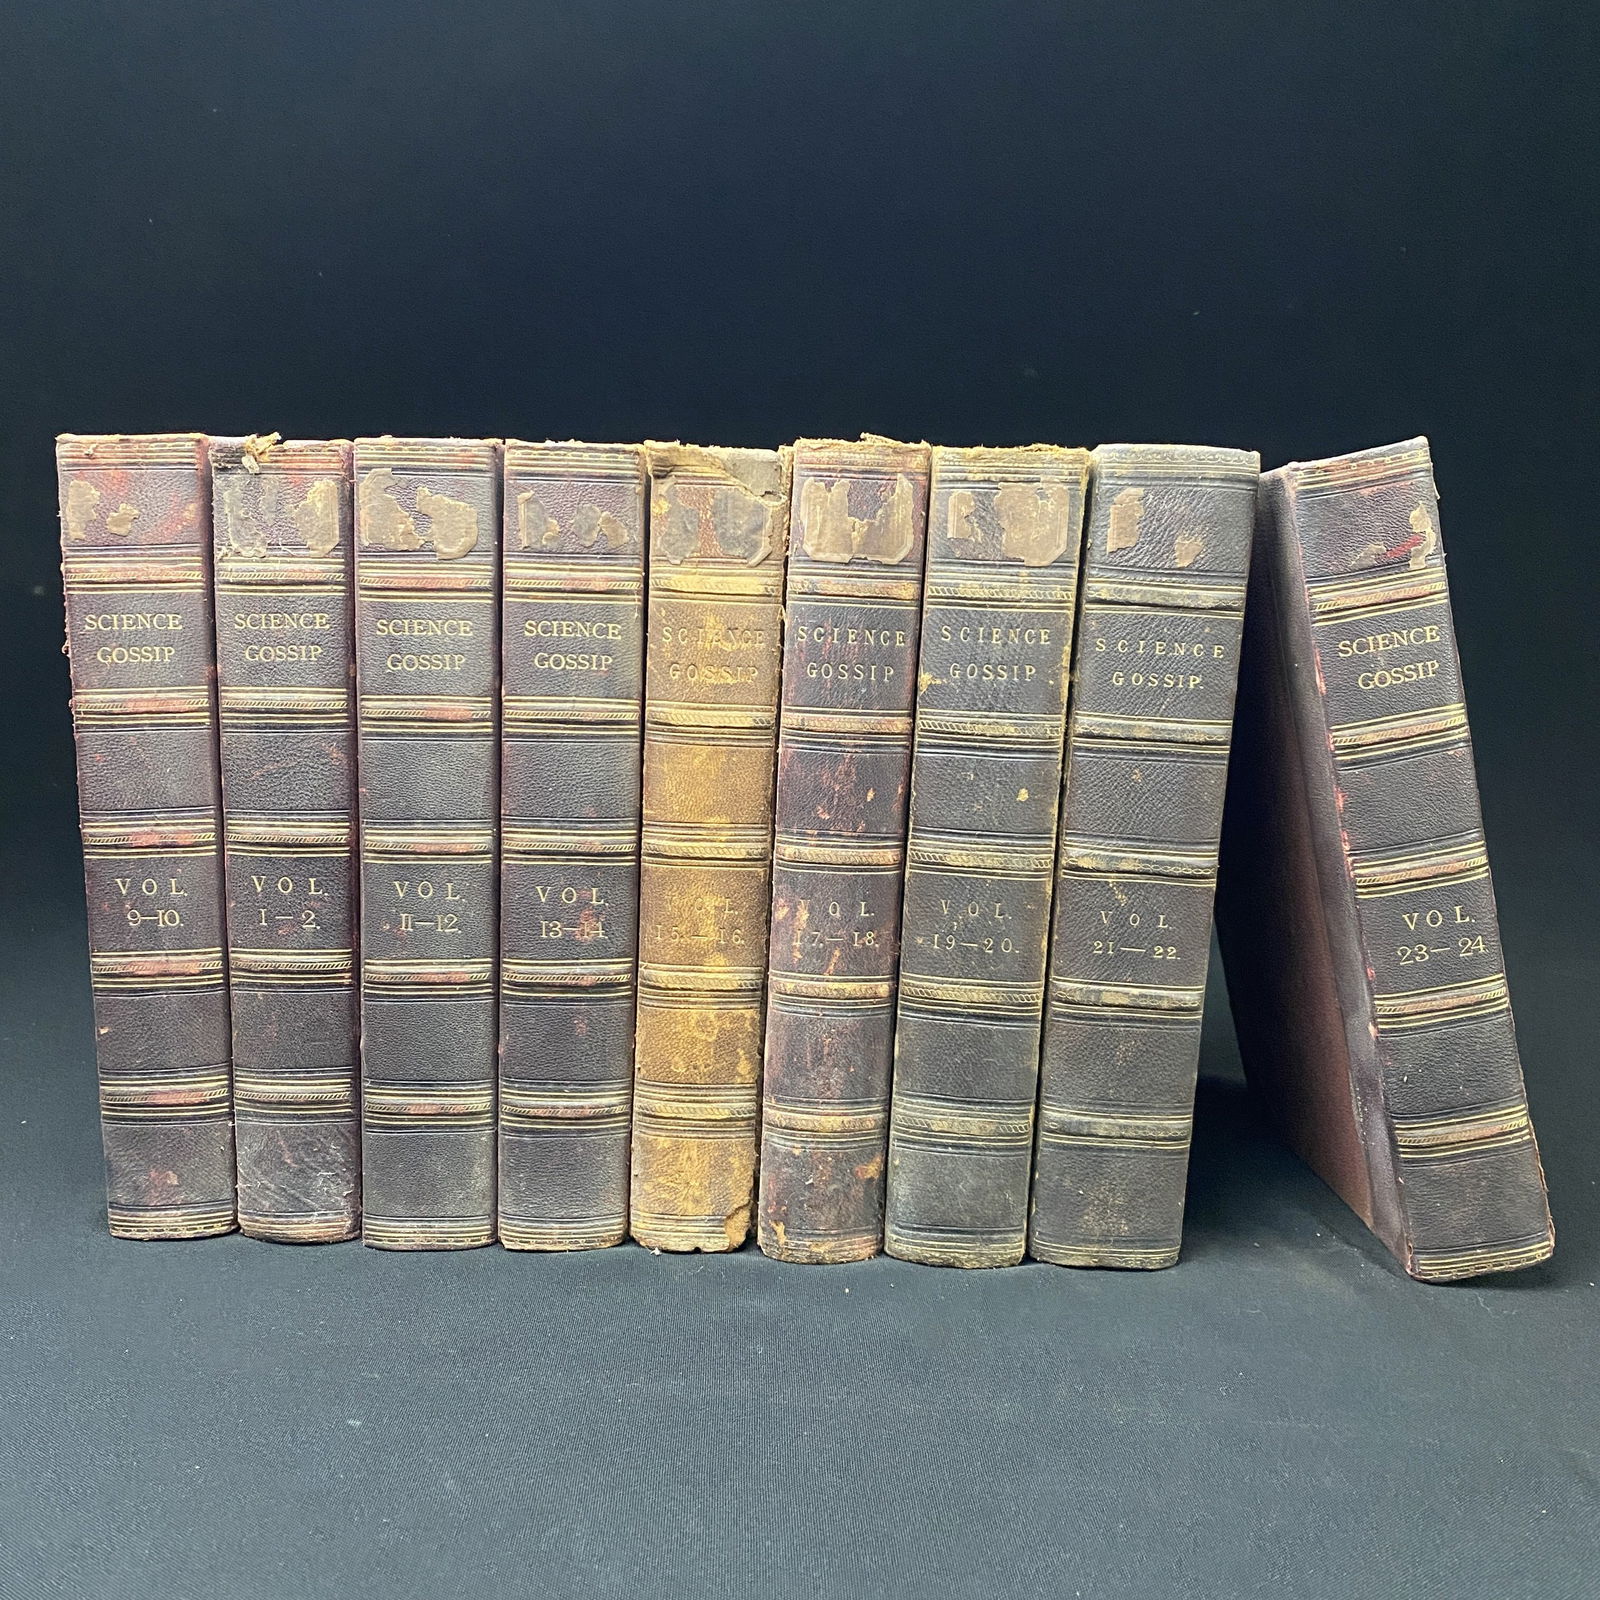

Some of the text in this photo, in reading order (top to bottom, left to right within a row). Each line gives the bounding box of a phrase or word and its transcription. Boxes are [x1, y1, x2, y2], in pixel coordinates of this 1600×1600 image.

[84, 613, 183, 630] SCIENCE
[233, 613, 330, 630] SCIENCE
[375, 619, 473, 636] SCIENCE
[524, 620, 622, 639] SCIENCE
[796, 626, 906, 647] SCIENCE
[941, 626, 1050, 645] SCIENCE
[1338, 625, 1440, 657] SCIENCE
[96, 646, 176, 664] GOSSIP
[245, 645, 323, 662] GOSSIP
[1095, 637, 1225, 659] SCIENCE
[387, 653, 466, 671] GOSSIP
[534, 652, 613, 671] GOSSIP
[669, 663, 759, 684] GOSSIP
[806, 662, 894, 682] GOSSIP
[950, 662, 1037, 682] GOSSIP
[1357, 660, 1439, 690] GOSSIP
[115, 878, 188, 896] VOL.
[251, 875, 329, 896] VOL.
[394, 881, 466, 901] VOL.
[536, 886, 609, 906] VOL.
[941, 900, 1012, 919] VOL.
[1402, 905, 1476, 931] VOL.
